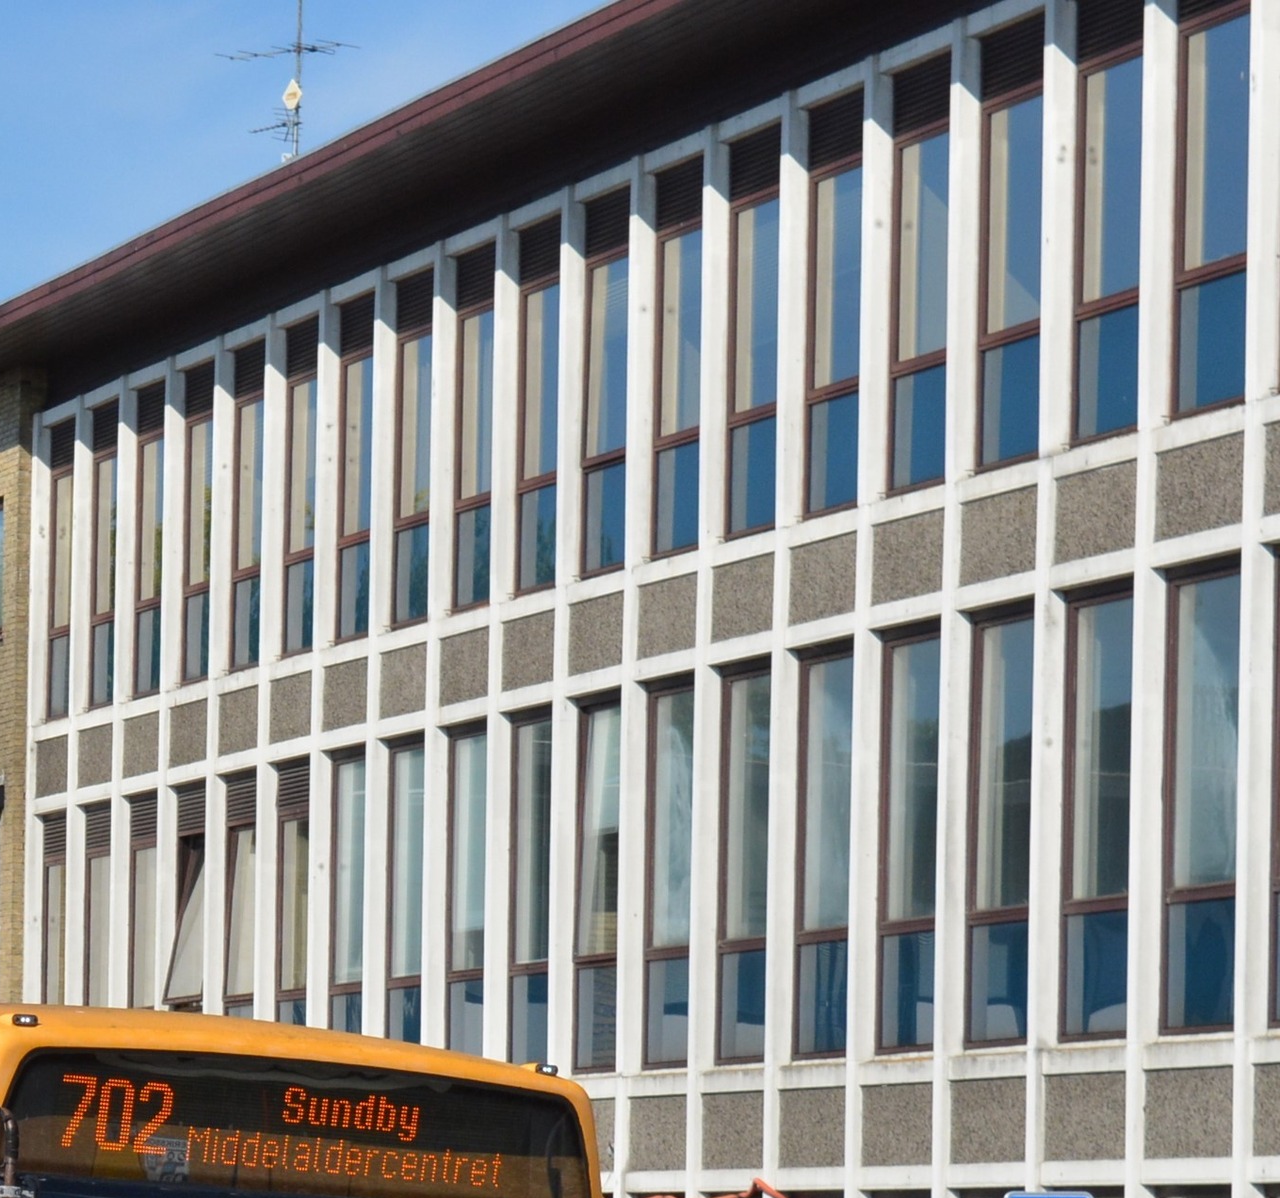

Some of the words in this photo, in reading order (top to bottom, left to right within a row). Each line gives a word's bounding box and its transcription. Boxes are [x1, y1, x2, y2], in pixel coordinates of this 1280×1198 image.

[61, 1074, 174, 1155] 702
[282, 1086, 420, 1142] Sundby
[186, 1125, 502, 1188] Middelaldercentret
